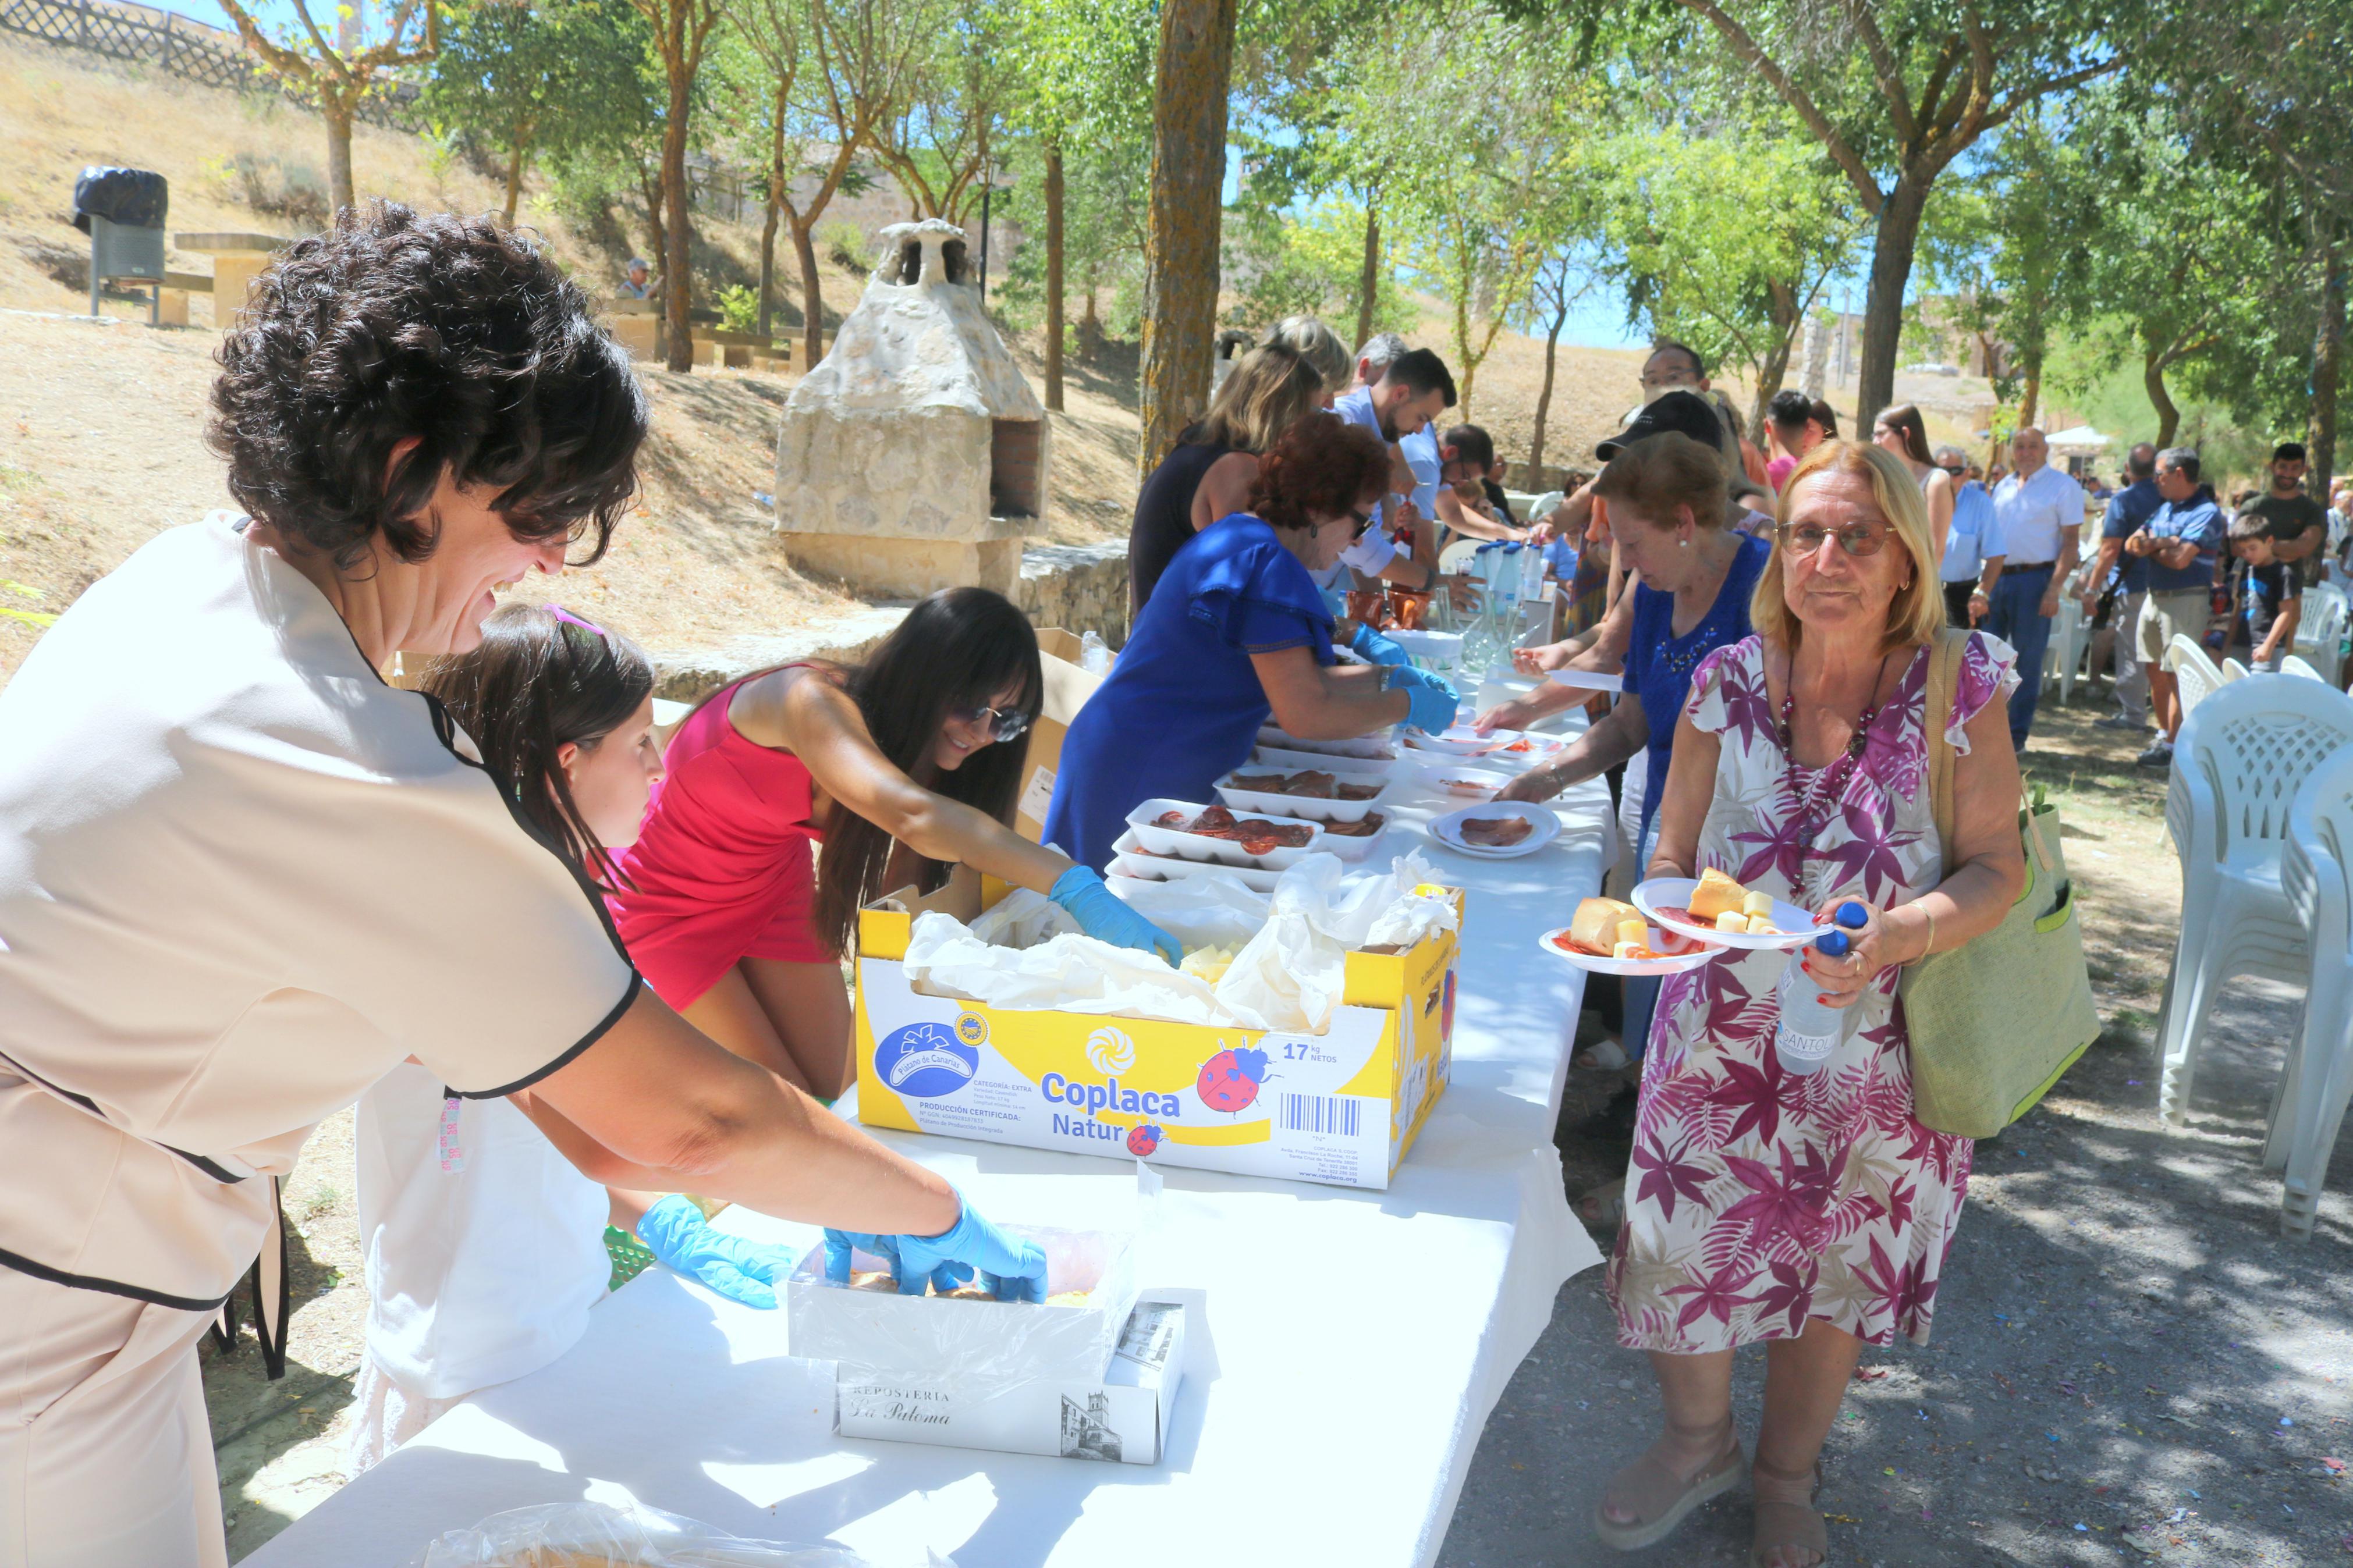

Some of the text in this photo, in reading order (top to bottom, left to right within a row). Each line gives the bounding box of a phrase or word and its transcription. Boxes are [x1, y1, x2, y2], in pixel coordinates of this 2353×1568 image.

[1783, 1029, 1831, 1051] SANTOL
[1283, 1043, 1320, 1060] 17 kg
[1311, 1054, 1337, 1063] NETOS
[922, 1055, 929, 1064] de
[931, 1054, 960, 1069] Canarias
[974, 1080, 1010, 1089] CATEGORÍA:
[1042, 1073, 1180, 1117] Coplaca
[920, 1101, 1021, 1121] PRODUCCIÓN CERTIFICADA:
[1053, 1113, 1123, 1141] Natur
[1298, 1172, 1357, 1183] www.coplaca.org
[883, 1401, 951, 1425] Paloma
